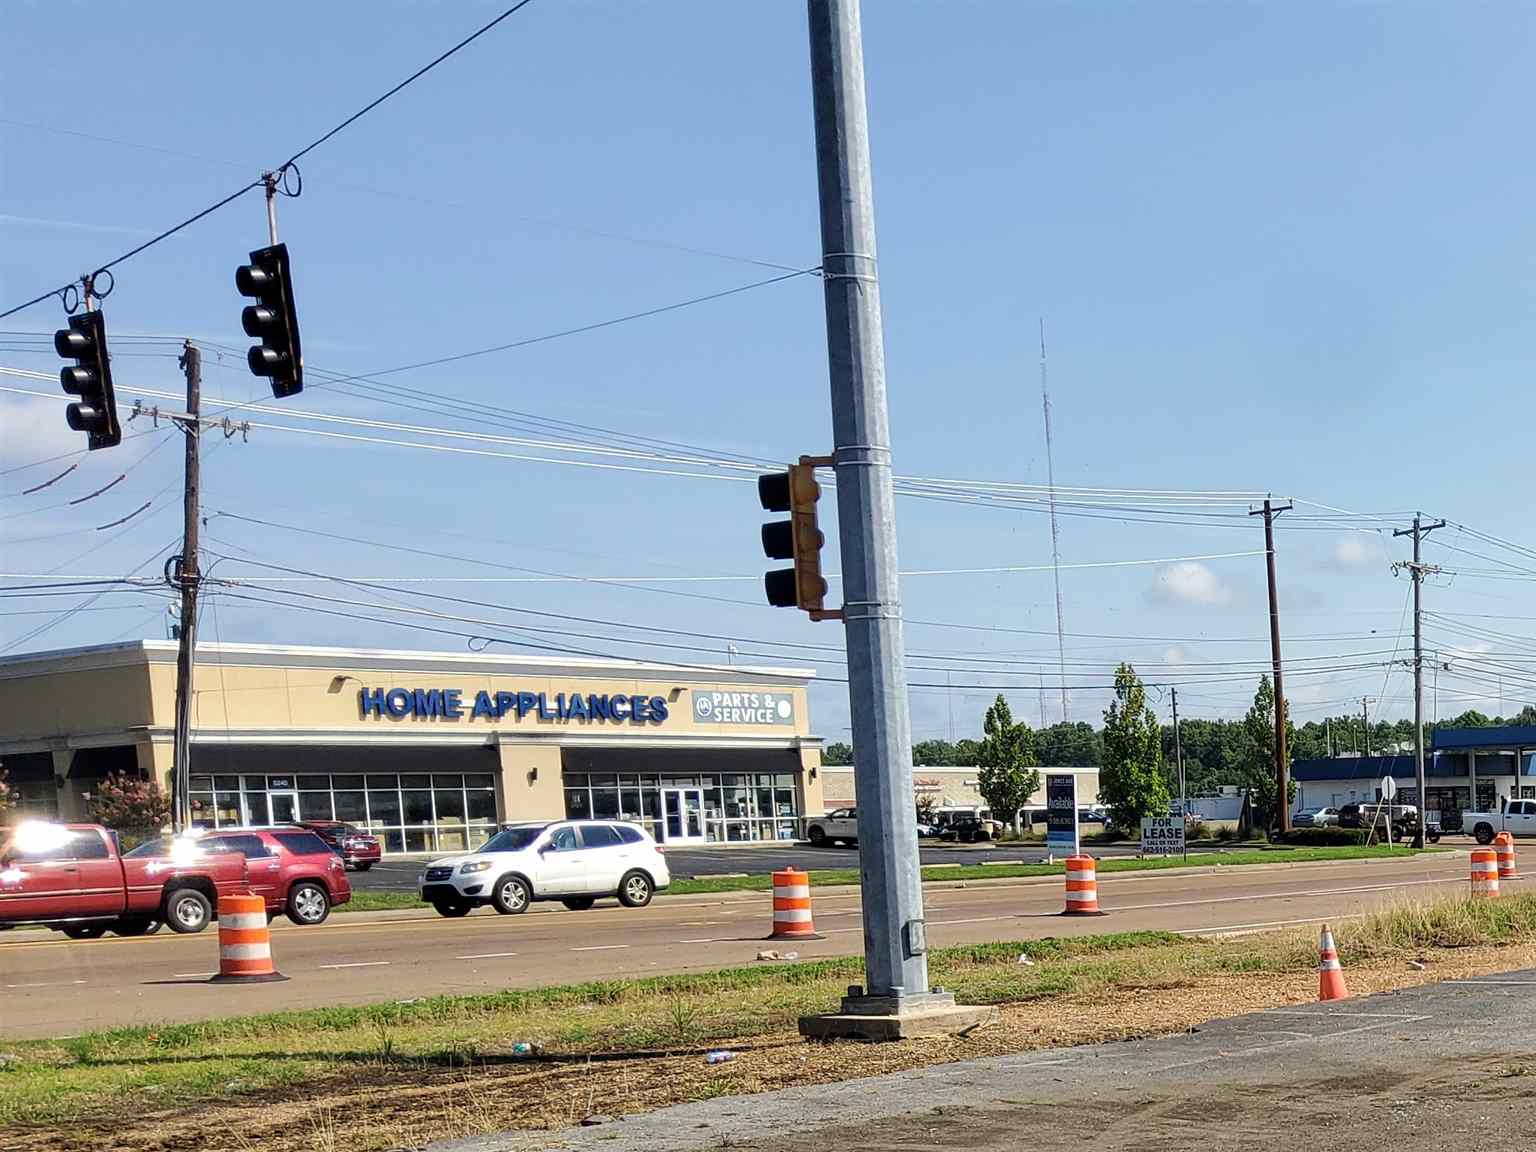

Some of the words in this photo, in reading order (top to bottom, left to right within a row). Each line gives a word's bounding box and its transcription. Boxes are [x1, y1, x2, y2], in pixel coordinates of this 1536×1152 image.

[360, 686, 465, 718] HOME
[471, 689, 670, 722] APPLIANCES
[712, 692, 760, 708] PARTS
[764, 694, 776, 708] &
[713, 707, 774, 723] SERVICE
[1152, 818, 1172, 827] FOR
[1143, 828, 1183, 839] LEASE
